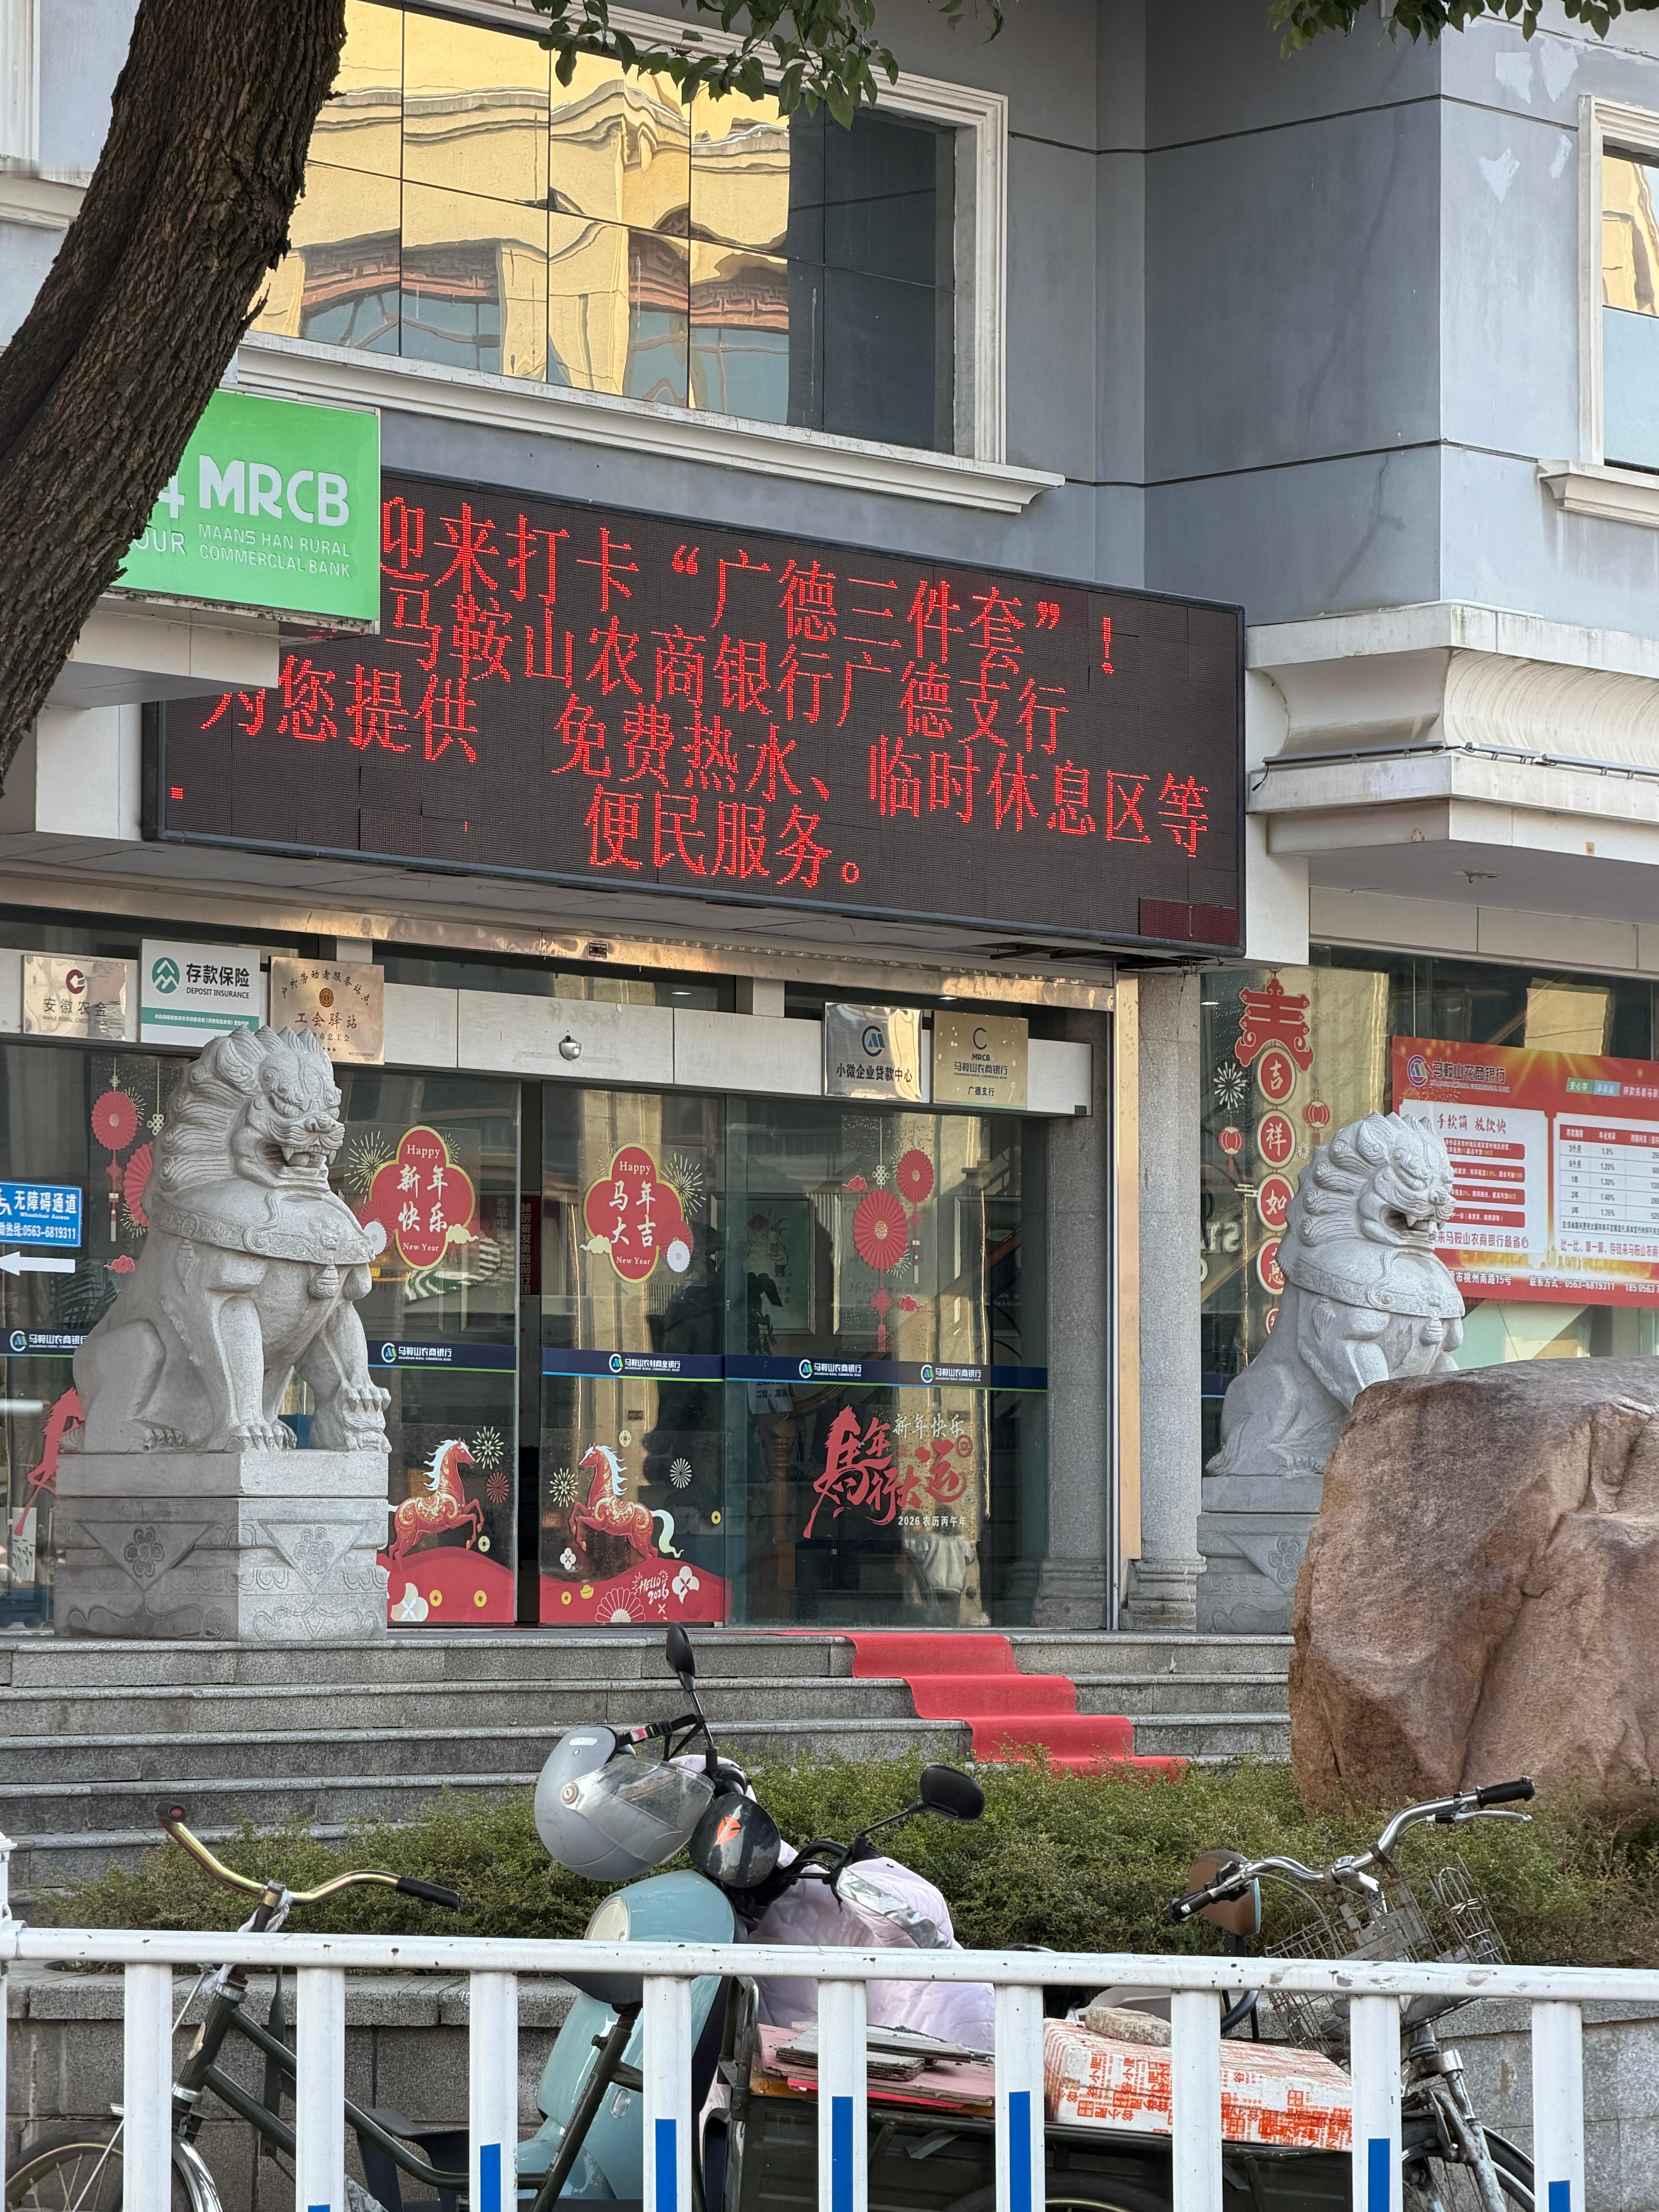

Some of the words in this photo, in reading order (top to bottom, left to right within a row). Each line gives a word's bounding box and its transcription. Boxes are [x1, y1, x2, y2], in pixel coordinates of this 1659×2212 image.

[199, 454, 349, 527] MRCB
[134, 527, 187, 556] OUR
[199, 523, 256, 545] MAANS
[262, 532, 294, 550] HAN
[300, 538, 350, 558] RURAL
[309, 559, 351, 578] BANK
[386, 587, 1068, 754] 马鞍山农商银行广德支行
[584, 783, 859, 888] 便民服务。
[186, 963, 250, 987] 存款保险
[186, 987, 213, 996] DEPOSIT
[214, 989, 250, 999] INSURANCE
[44, 997, 106, 1017] 安徽农金
[295, 1012, 357, 1029] 工会驿站
[837, 1063, 912, 1083] 小微企业贷款中心
[954, 1062, 1008, 1075] 马鞍山农商银行
[1433, 1061, 1505, 1083] 马鞍山农商银行
[968, 1086, 995, 1097] 广德支行
[406, 1144, 440, 1159] Happy
[619, 1161, 651, 1175] Happy
[396, 1164, 449, 1201] 新年
[14, 1190, 77, 1214] 无障碍通道
[609, 1180, 656, 1216] 马年
[397, 1202, 448, 1234] 快乐
[609, 1214, 656, 1248] 大吉
[403, 1242, 419, 1251] New
[420, 1243, 440, 1252] Year
[616, 1256, 632, 1264] New
[634, 1257, 651, 1266] Year
[814, 1362, 862, 1373] 马鞍山农商银行
[935, 1368, 981, 1378] 马鞍山农商银行
[892, 1413, 965, 1439] 新年快乐
[898, 1516, 920, 1526] 2026
[923, 1516, 967, 1527] 农历丙午年
[635, 1577, 661, 1595] HELLO
[648, 1583, 669, 1605] 2026
[1095, 2107, 1134, 2121] 谷小肥
